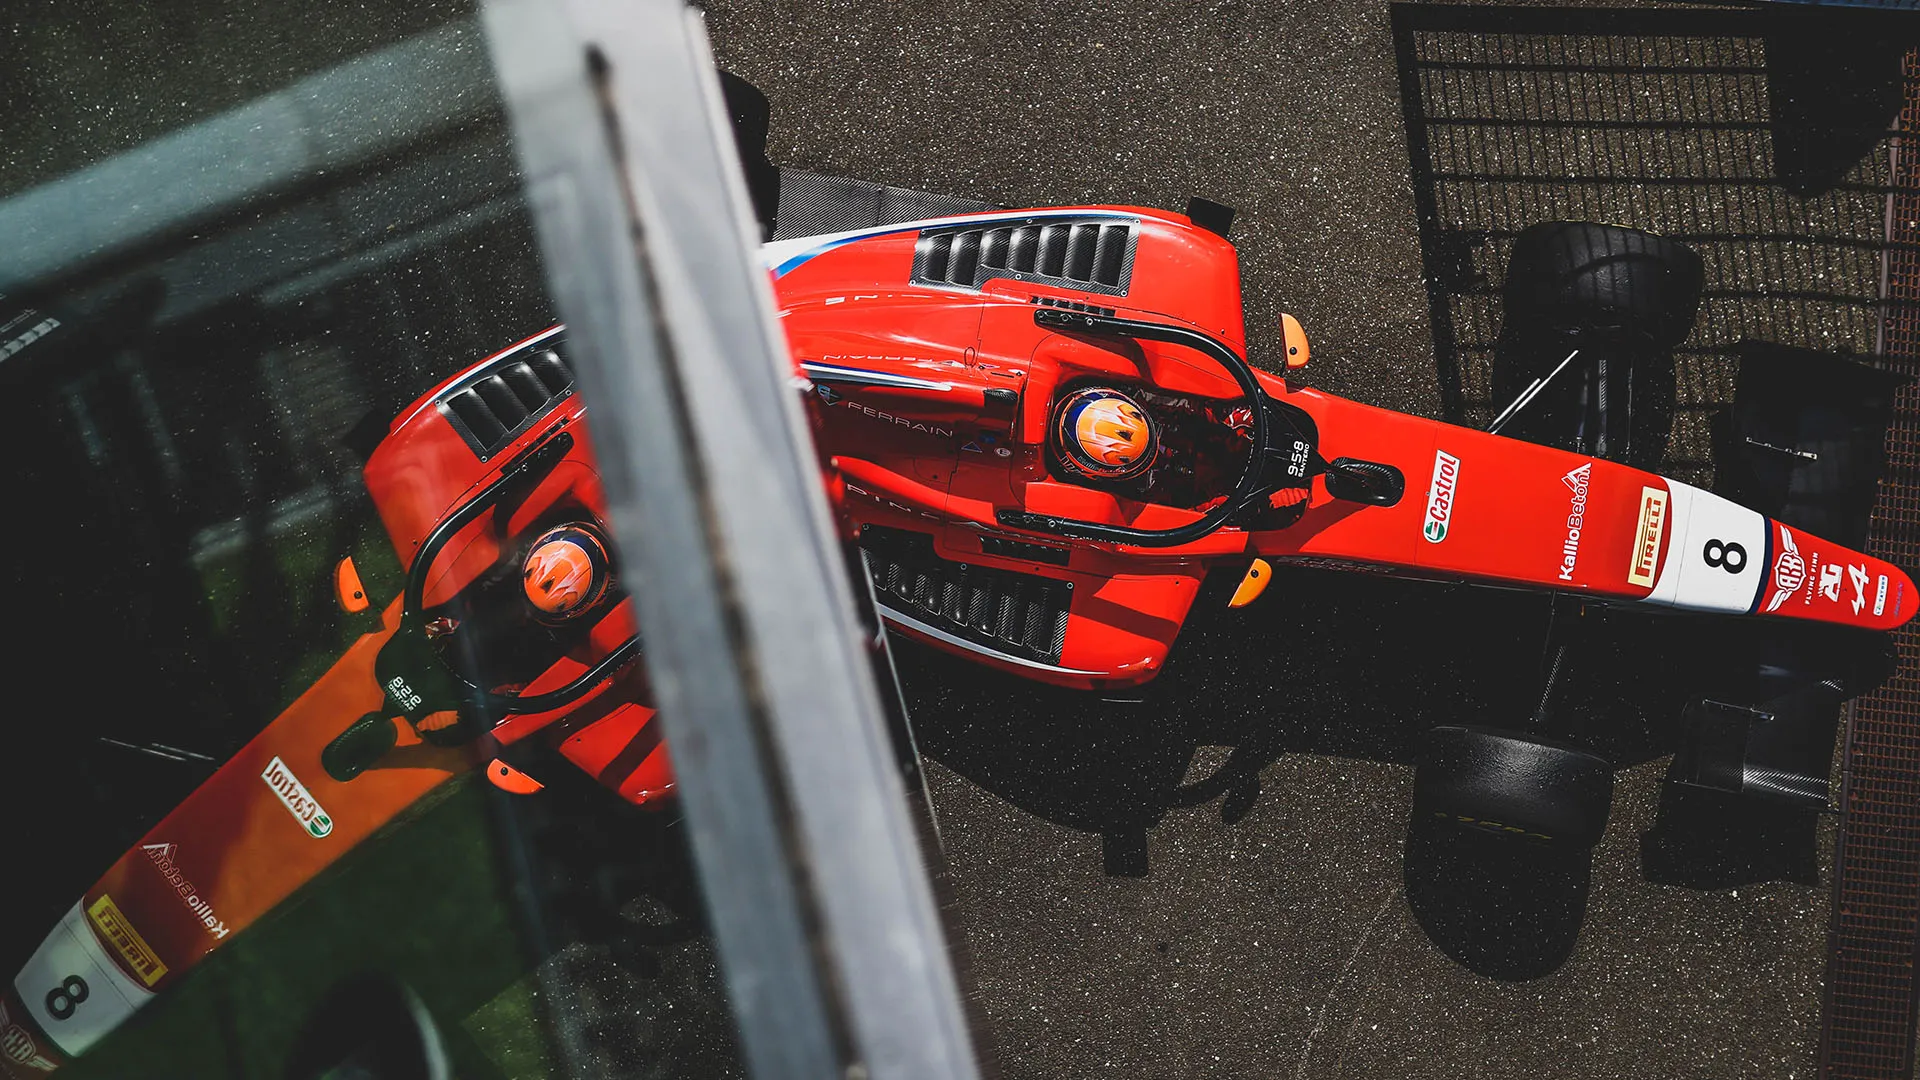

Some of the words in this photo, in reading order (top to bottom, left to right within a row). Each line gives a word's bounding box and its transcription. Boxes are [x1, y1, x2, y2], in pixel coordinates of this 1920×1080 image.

[847, 401, 953, 438] FERRAIN
[1298, 443, 1310, 478] SANTERO
[1429, 455, 1457, 522] Castrol
[1635, 496, 1661, 578] PIRELLI
[1703, 538, 1748, 574] 8
